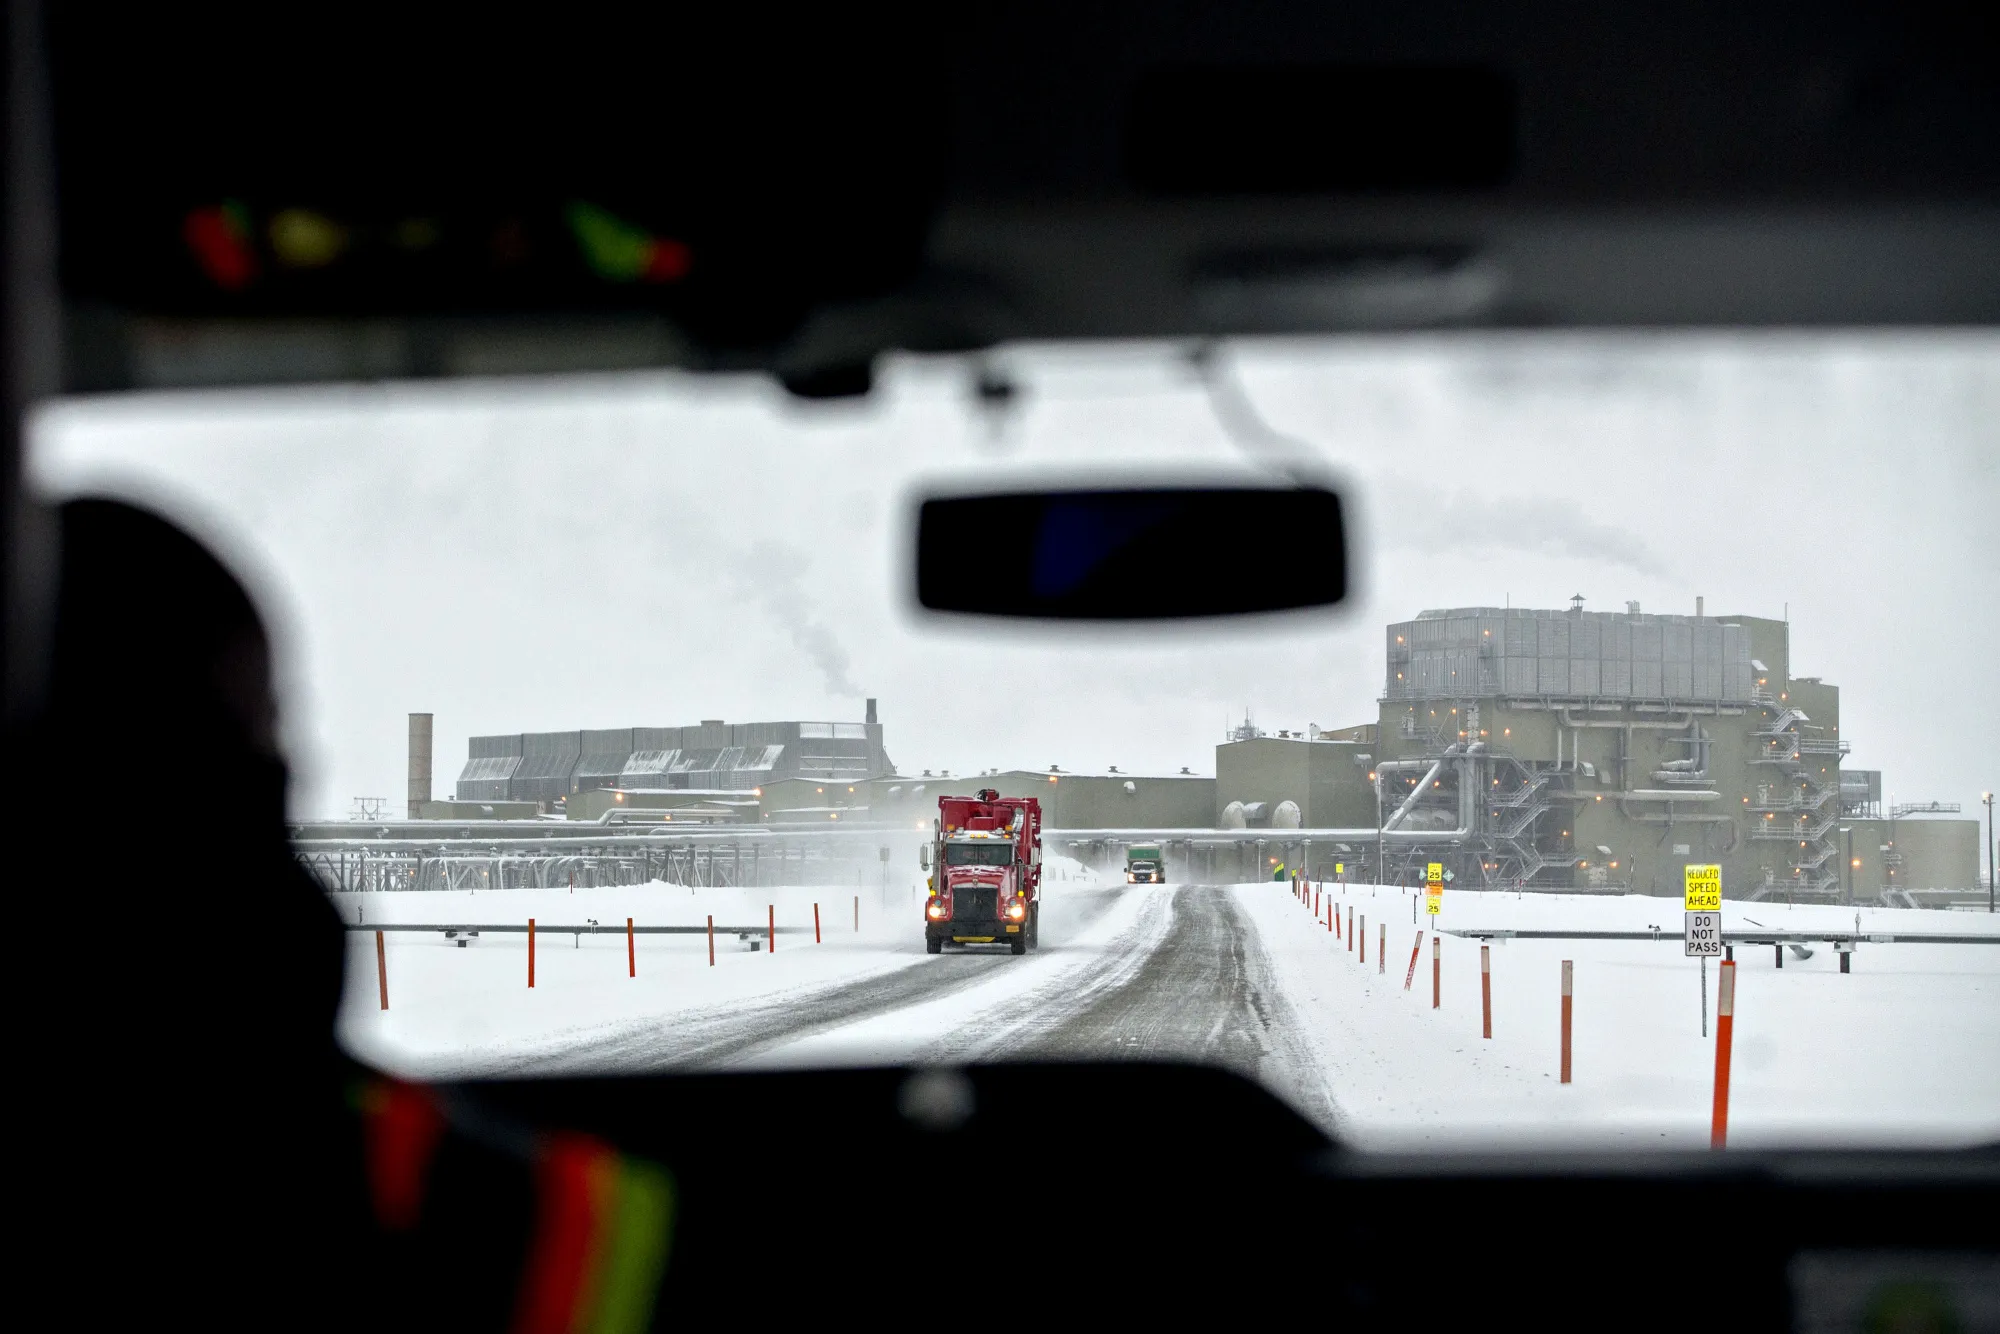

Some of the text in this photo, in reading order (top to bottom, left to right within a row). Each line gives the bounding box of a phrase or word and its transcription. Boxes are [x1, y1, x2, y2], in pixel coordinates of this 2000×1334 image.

[1687, 868, 1719, 879] REDUCED
[1688, 882, 1717, 893] SPEED
[1688, 896, 1718, 905] AHEAD
[1695, 916, 1711, 926] DO
[1692, 929, 1714, 940] NOT
[1688, 942, 1718, 952] PASS
